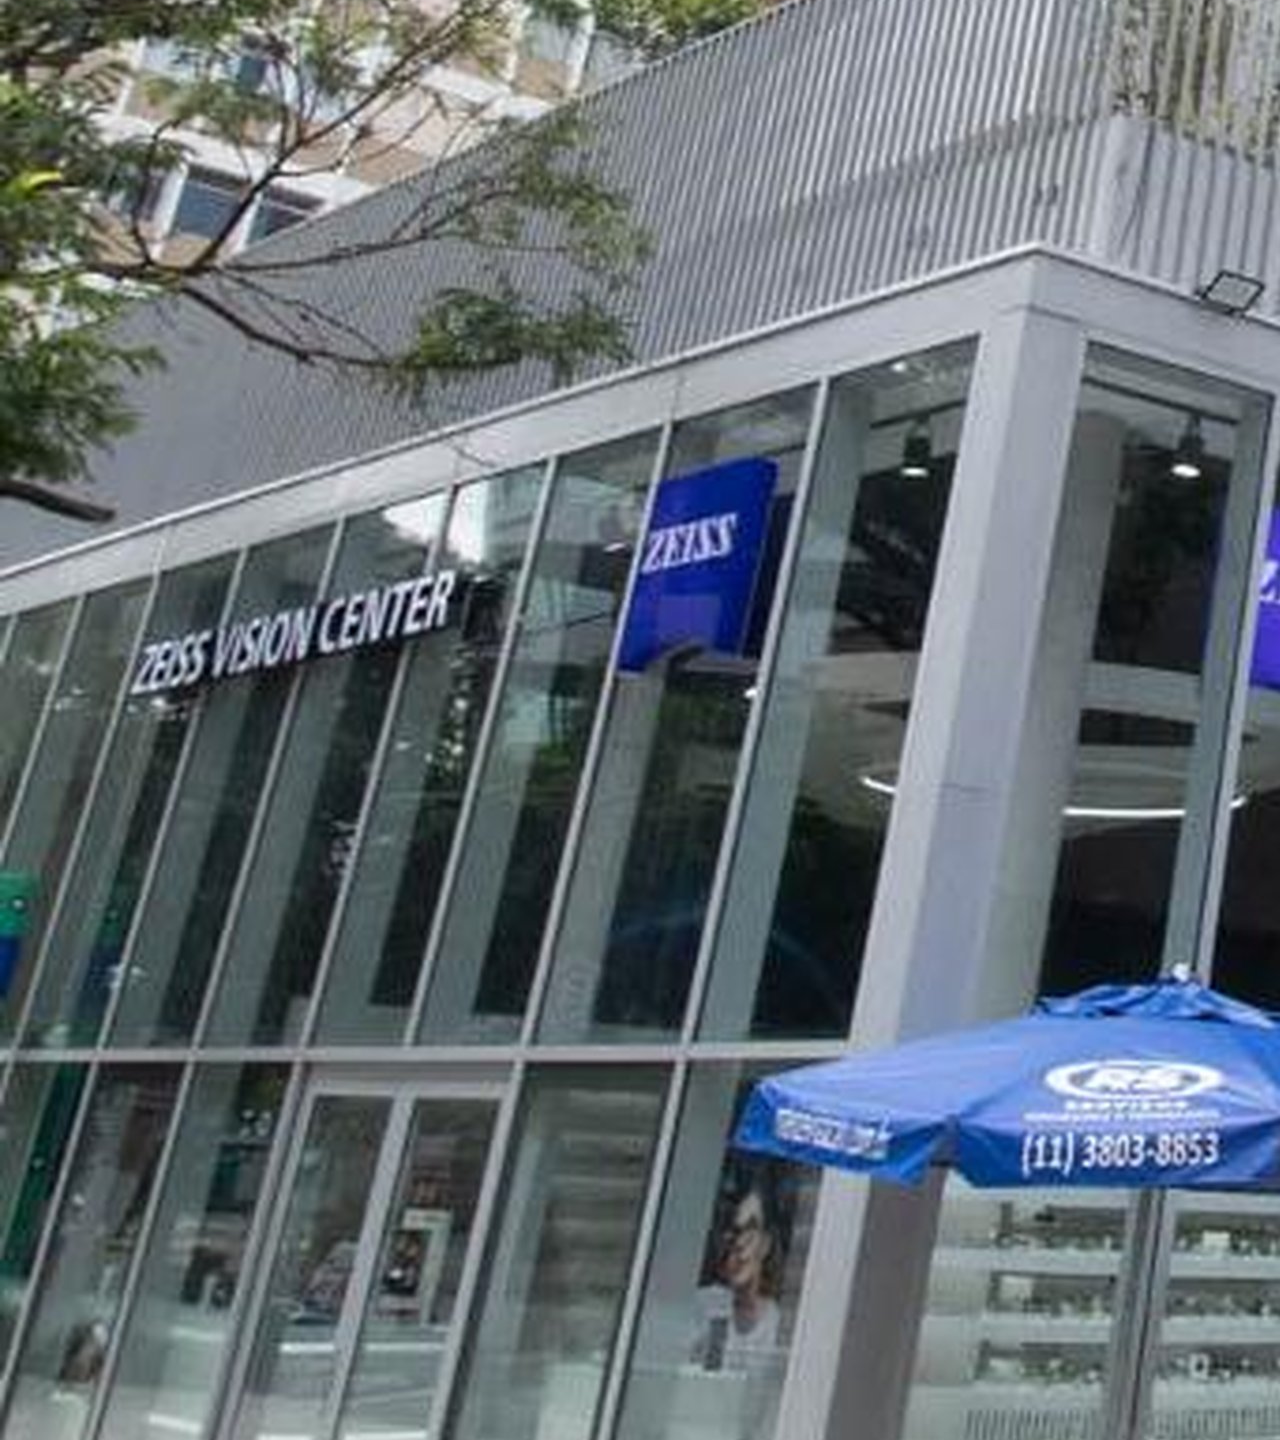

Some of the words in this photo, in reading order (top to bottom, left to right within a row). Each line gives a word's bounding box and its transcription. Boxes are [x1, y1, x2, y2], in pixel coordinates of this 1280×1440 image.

[641, 512, 738, 575] ZEISS
[131, 629, 213, 695] ZEISS
[212, 604, 318, 679] VISION
[317, 570, 457, 654] CENTER
[1021, 1130, 1075, 1176] (11)
[1081, 1132, 1222, 1168] 3803-8853
